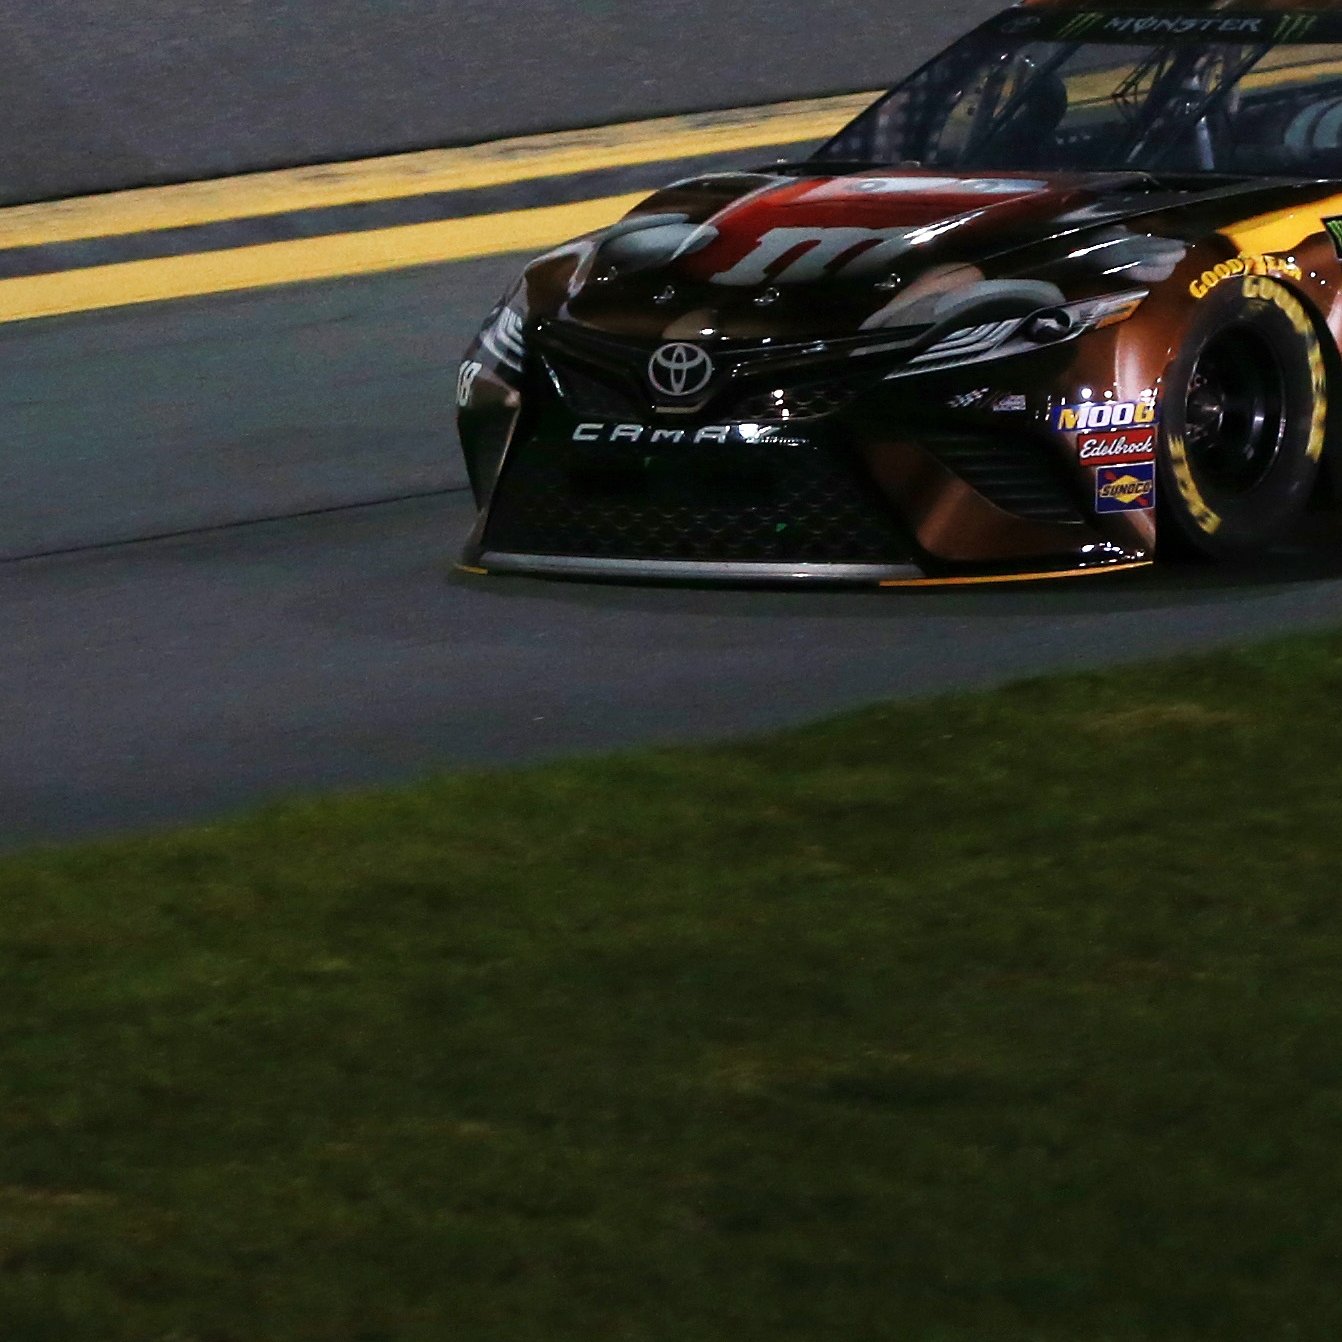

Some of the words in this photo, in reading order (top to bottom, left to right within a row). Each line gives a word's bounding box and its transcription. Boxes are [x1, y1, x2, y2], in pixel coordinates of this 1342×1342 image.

[1058, 402, 1156, 430] MOOG
[1080, 435, 1154, 458] Edelbrock
[1100, 479, 1152, 497] SUNOCO
